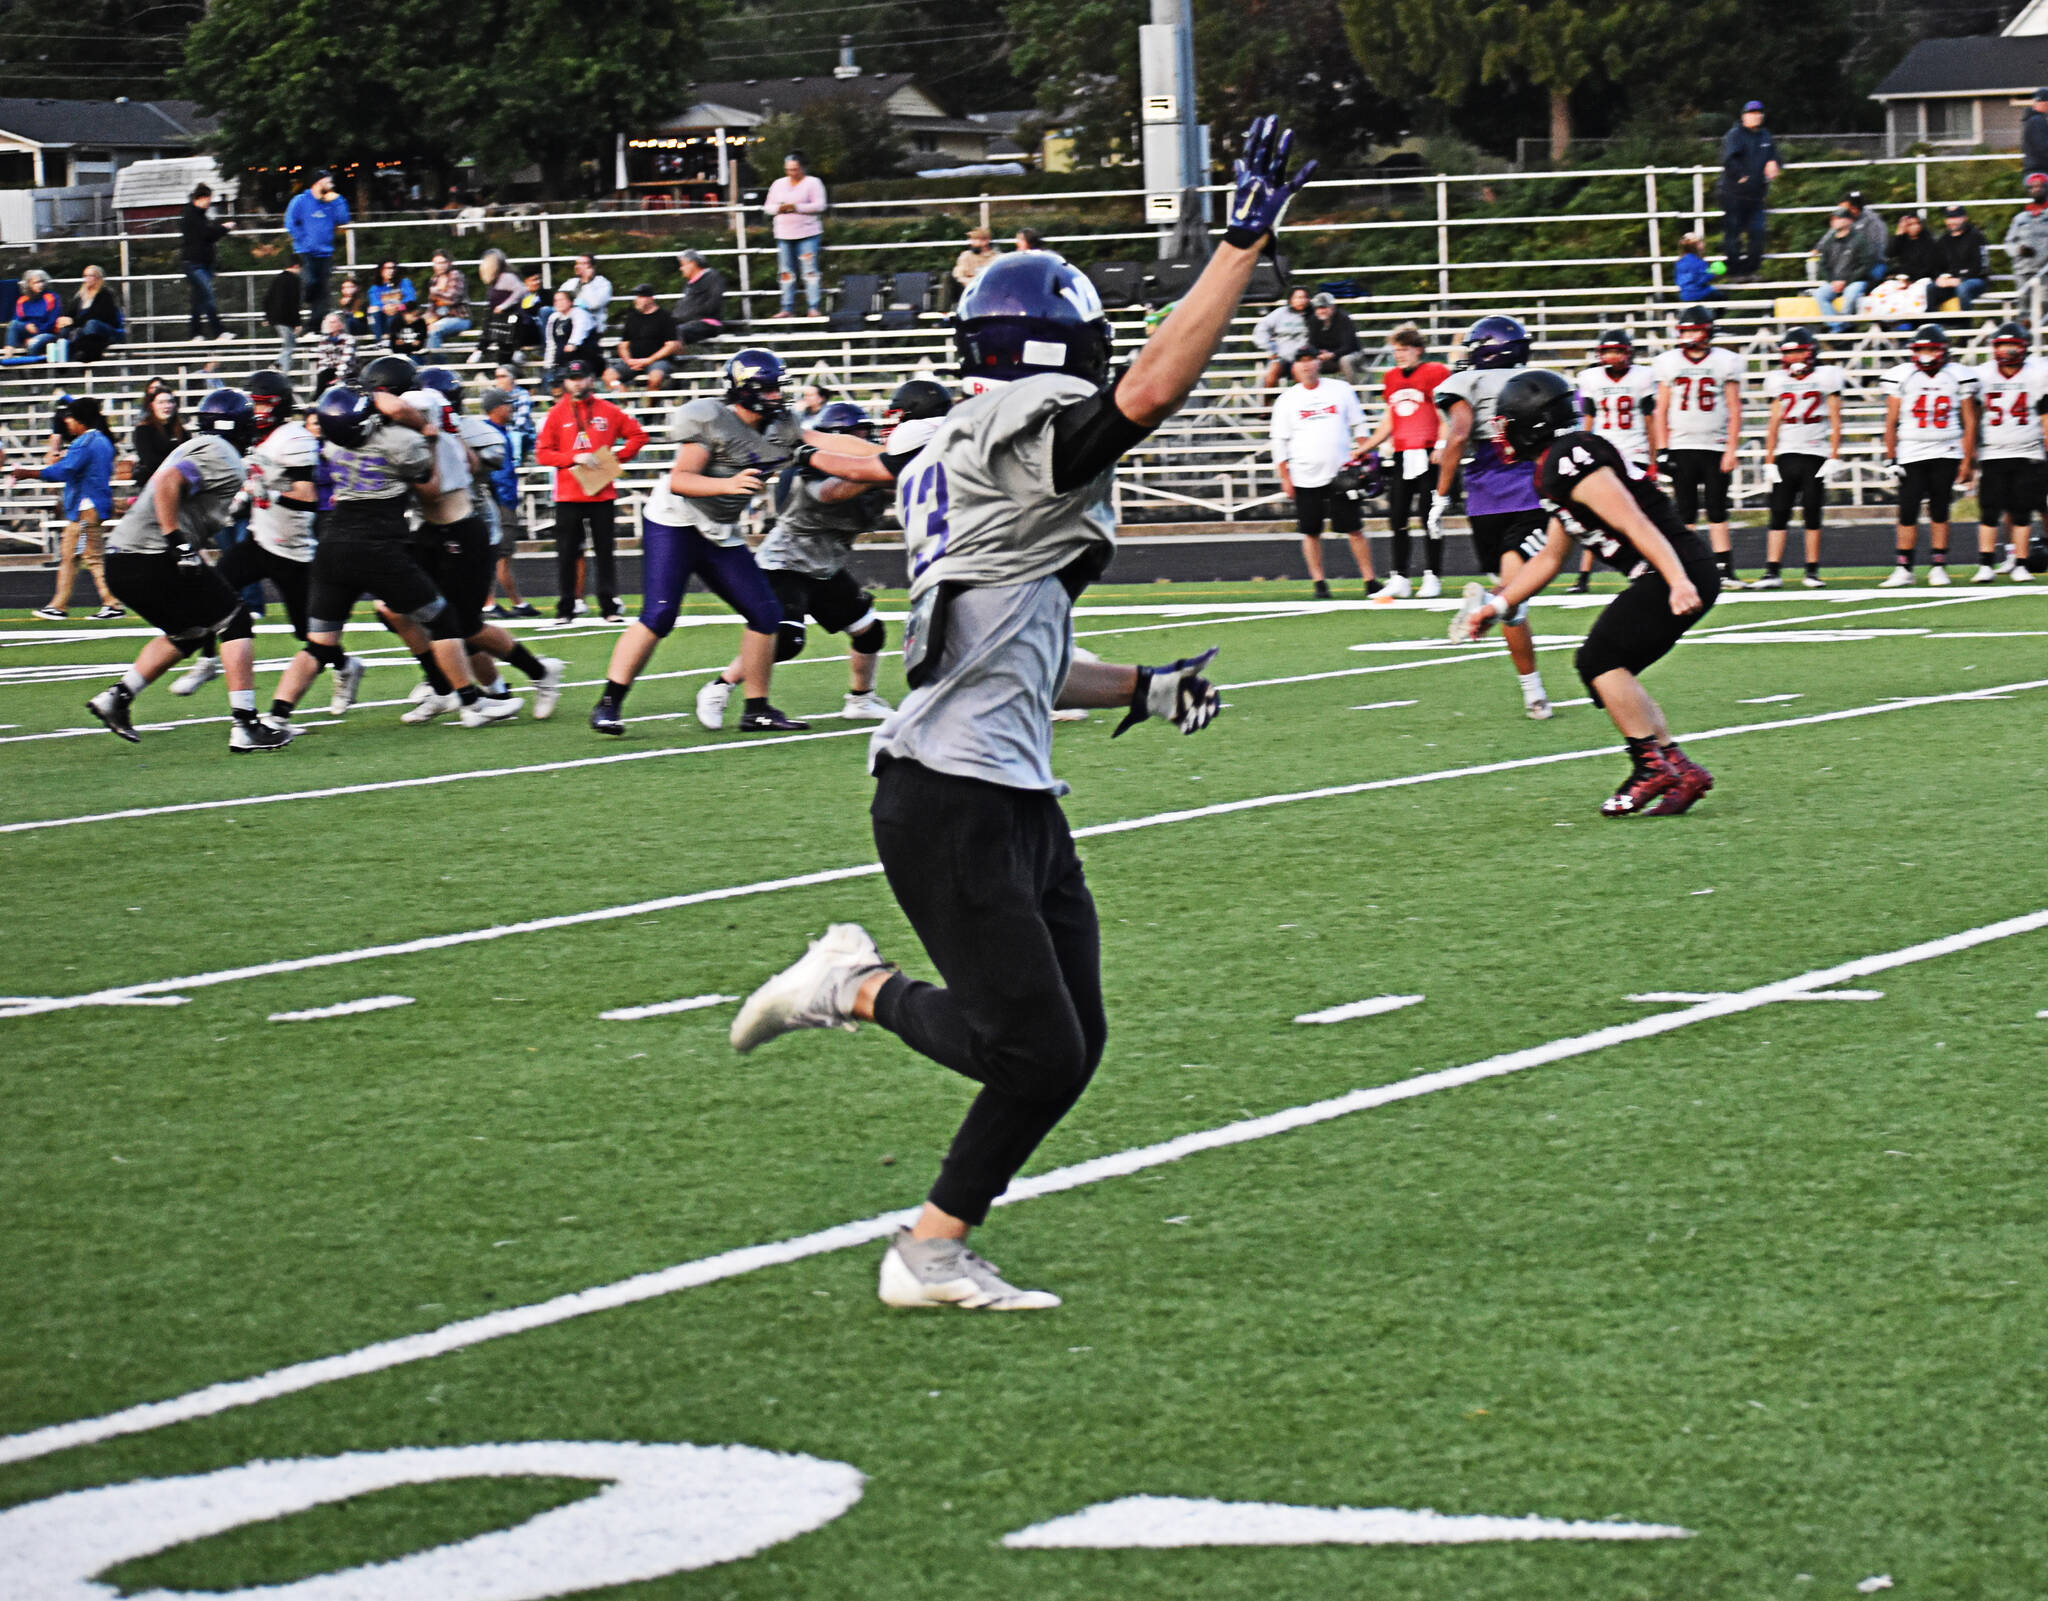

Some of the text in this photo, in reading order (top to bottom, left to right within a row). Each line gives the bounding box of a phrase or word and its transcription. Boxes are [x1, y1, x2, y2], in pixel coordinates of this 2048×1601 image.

[1674, 377, 1717, 412] 76
[1778, 390, 1823, 424] 22
[1912, 393, 1953, 429] 48
[1985, 391, 2029, 426] 54
[1600, 395, 1633, 429] 18
[1558, 446, 1595, 476] 44
